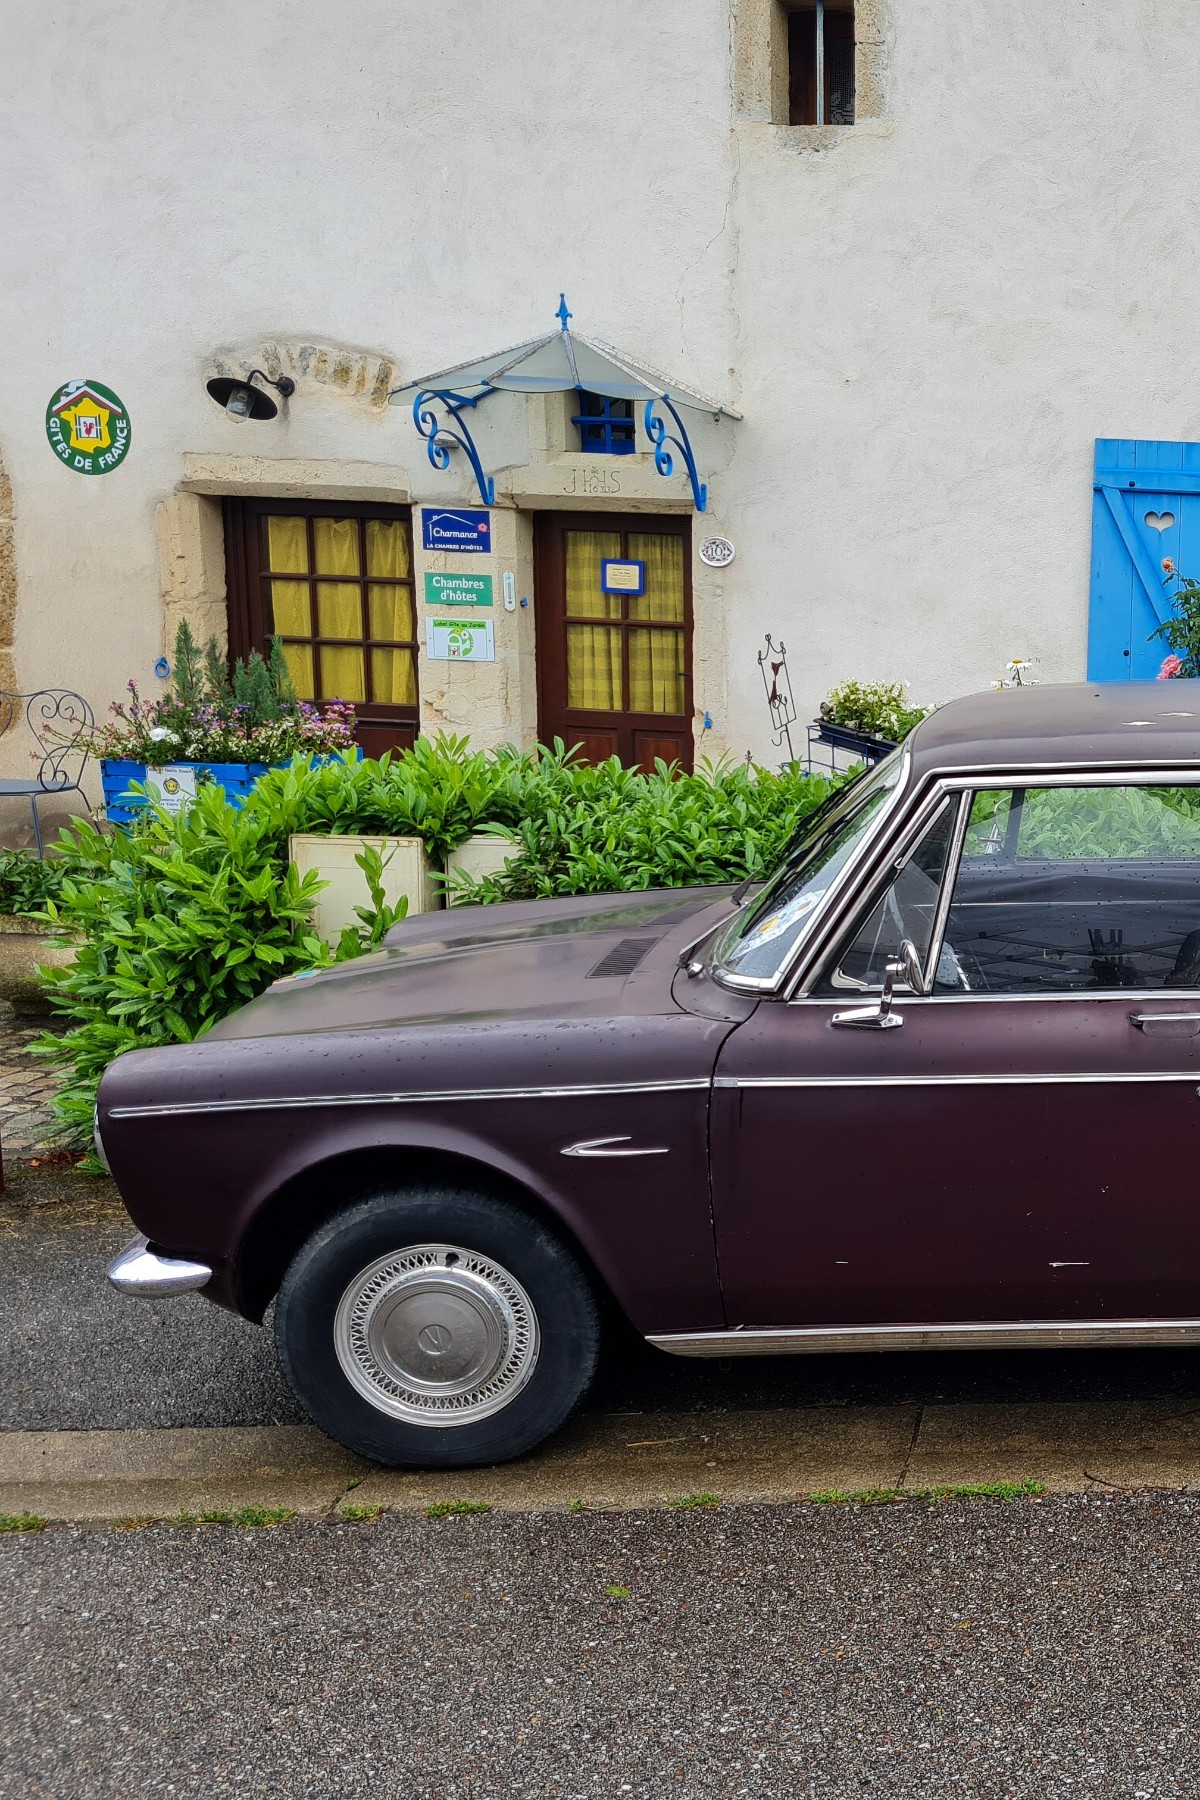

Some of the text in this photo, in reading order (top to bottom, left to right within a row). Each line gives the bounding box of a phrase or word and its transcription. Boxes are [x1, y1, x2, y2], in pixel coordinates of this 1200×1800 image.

[49, 417, 128, 470] GITES DE FRANCE
[433, 527, 478, 539] Charmance
[432, 576, 485, 589] Chambres
[440, 589, 477, 602] d'hôtes
